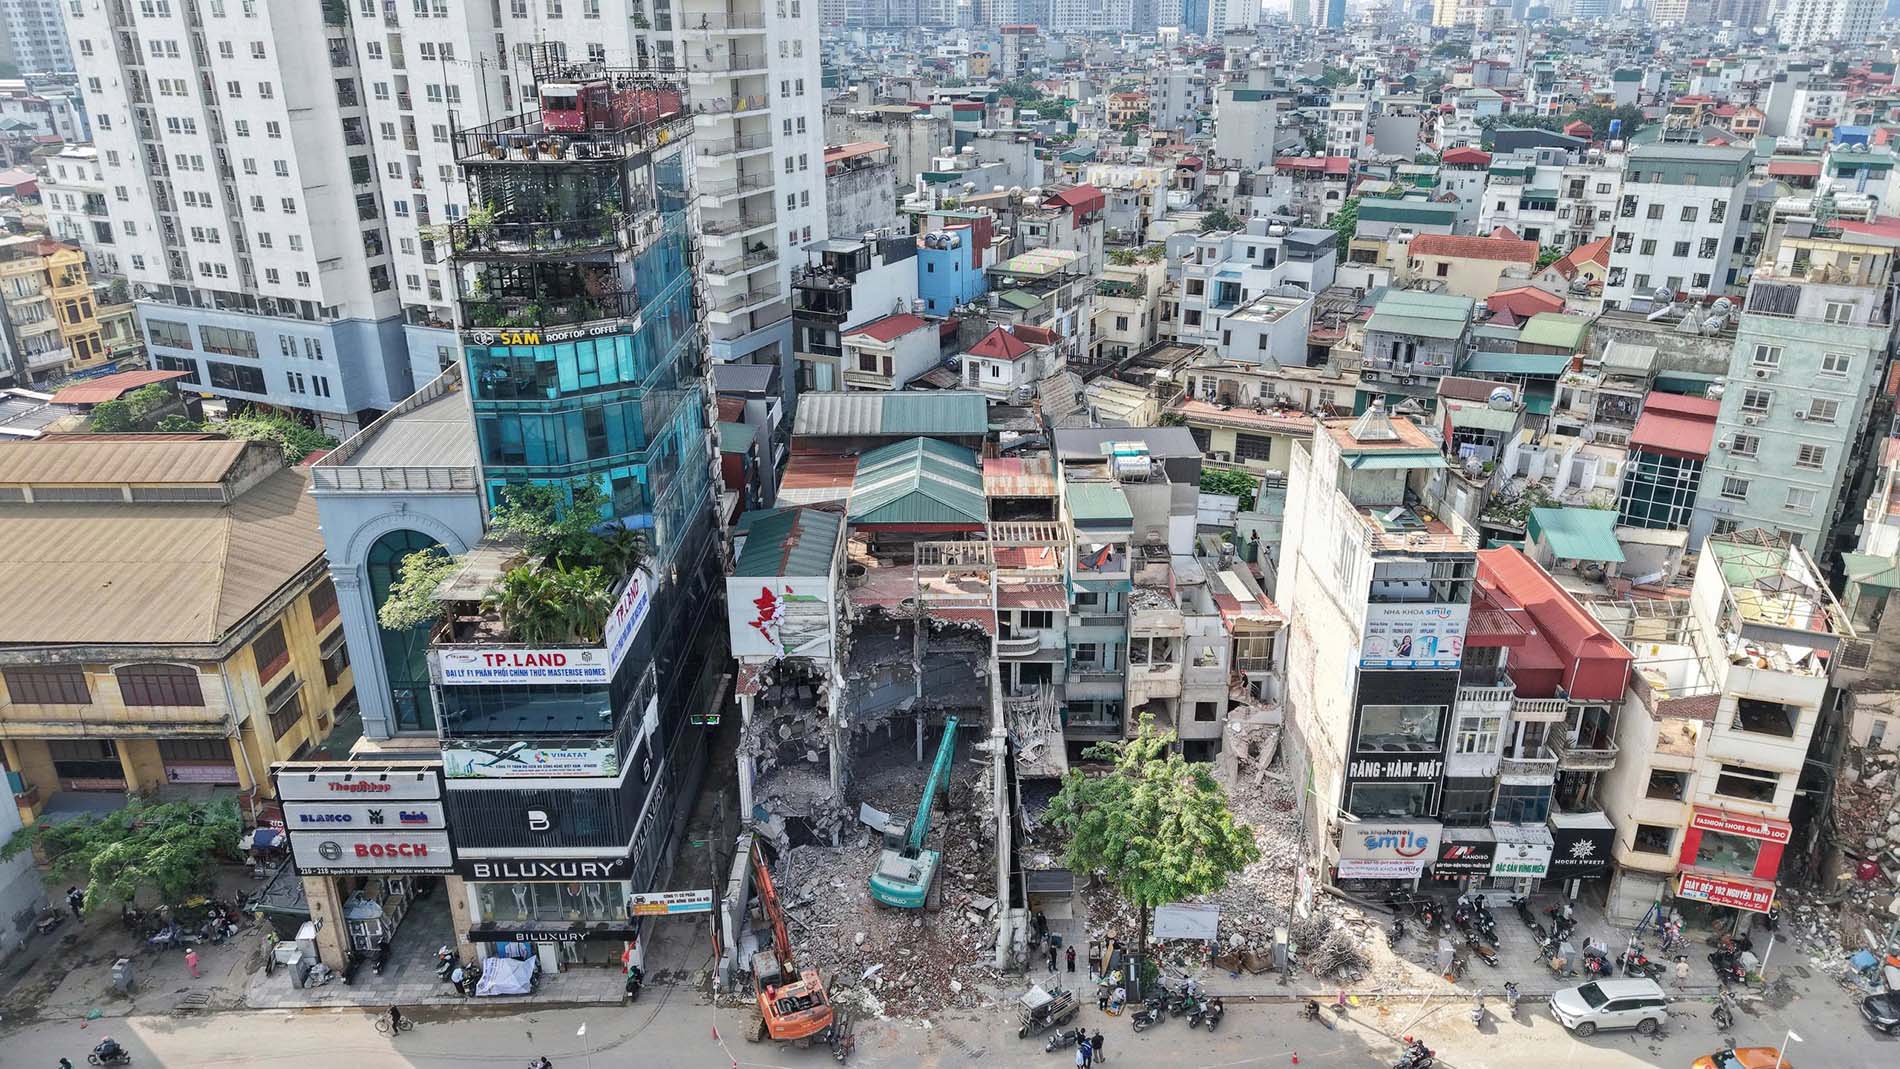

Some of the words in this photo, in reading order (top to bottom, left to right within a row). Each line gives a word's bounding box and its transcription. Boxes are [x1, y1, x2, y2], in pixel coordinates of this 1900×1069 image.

[500, 332, 540, 345] SAM
[546, 329, 585, 343] ROOFTOP
[589, 325, 617, 336] COFFEE
[483, 653, 567, 667] TP.LAND
[547, 668, 583, 676] MASTERISE
[584, 668, 606, 676] HOMES
[1696, 817, 1724, 827] FASHION
[1725, 822, 1745, 831] SHOES
[1363, 831, 1429, 851] smile
[354, 843, 428, 858] BOSCH
[473, 862, 614, 878] BILUXURY
[1684, 879, 1699, 891] GIÀY
[516, 932, 586, 942] BILUXURY
